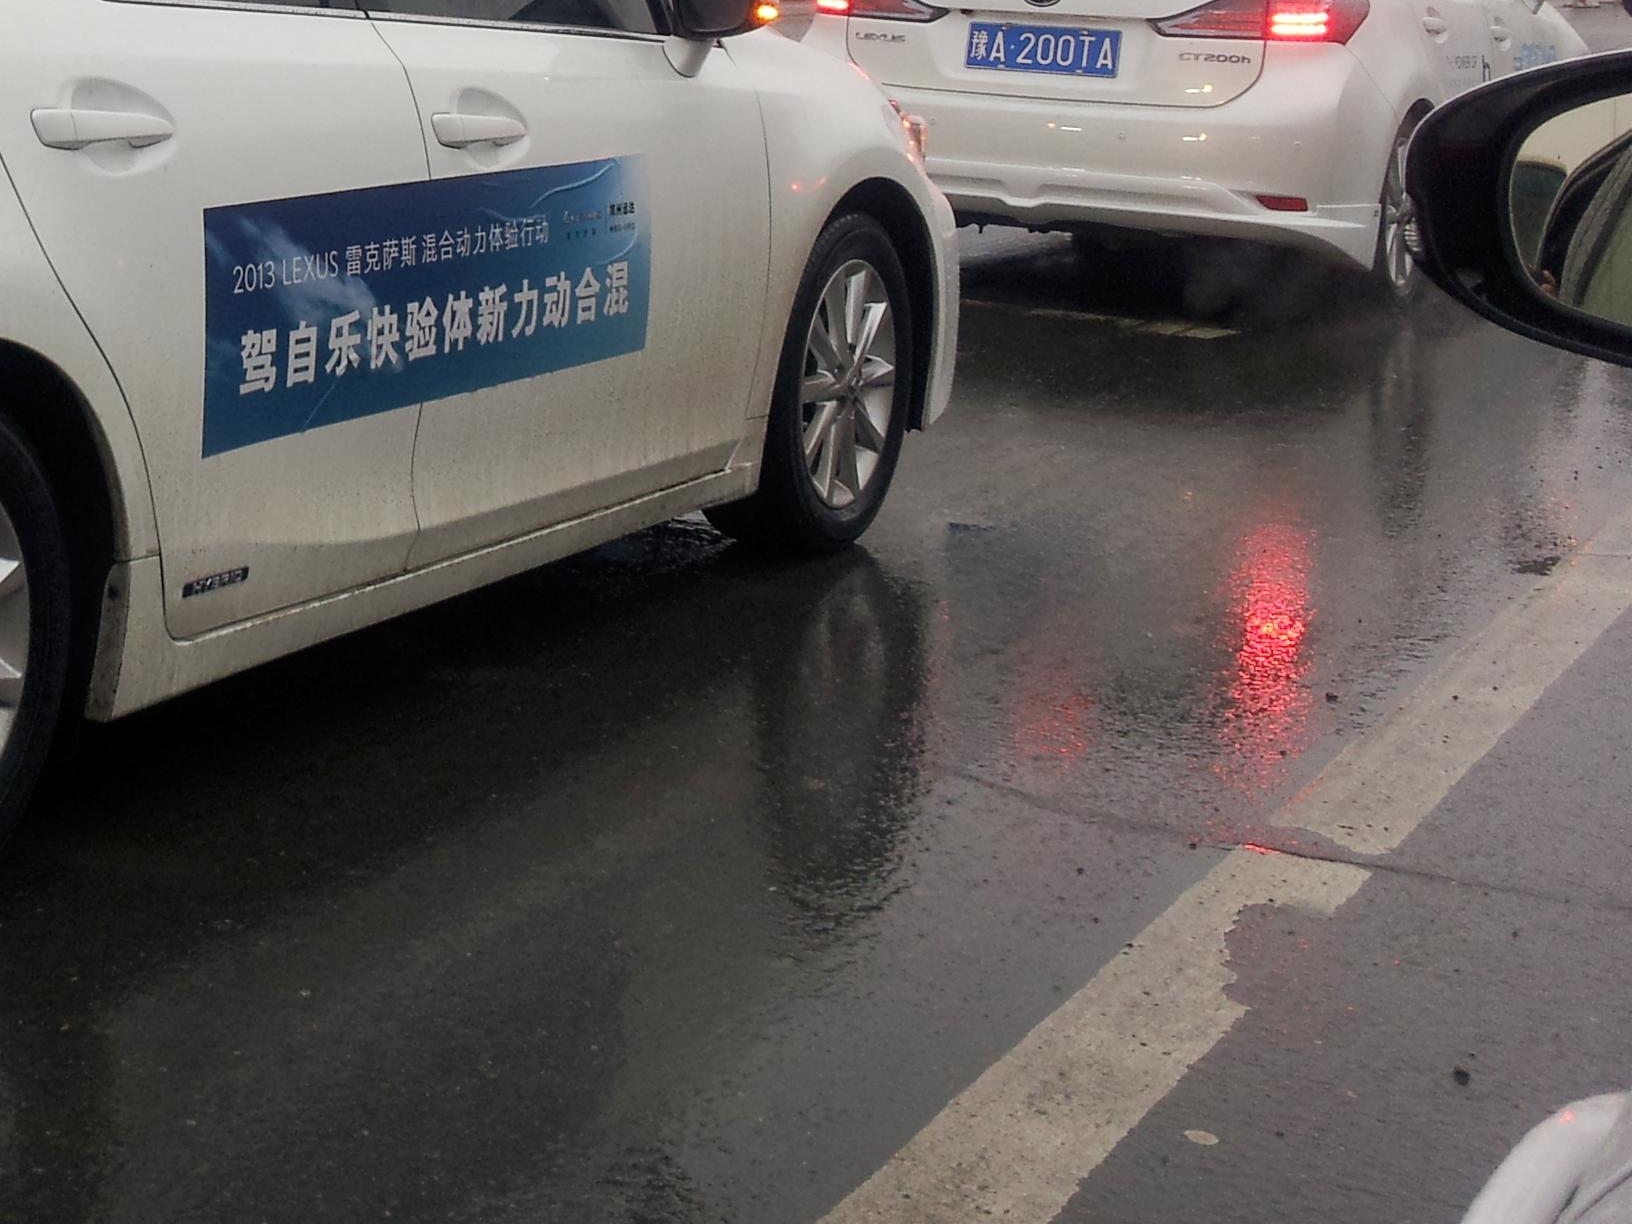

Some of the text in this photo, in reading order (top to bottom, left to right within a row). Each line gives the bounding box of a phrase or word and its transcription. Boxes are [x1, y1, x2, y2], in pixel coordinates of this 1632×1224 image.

[232, 218, 550, 295] 2013 LEXUS 雷克萨斯 混合动力体验行动
